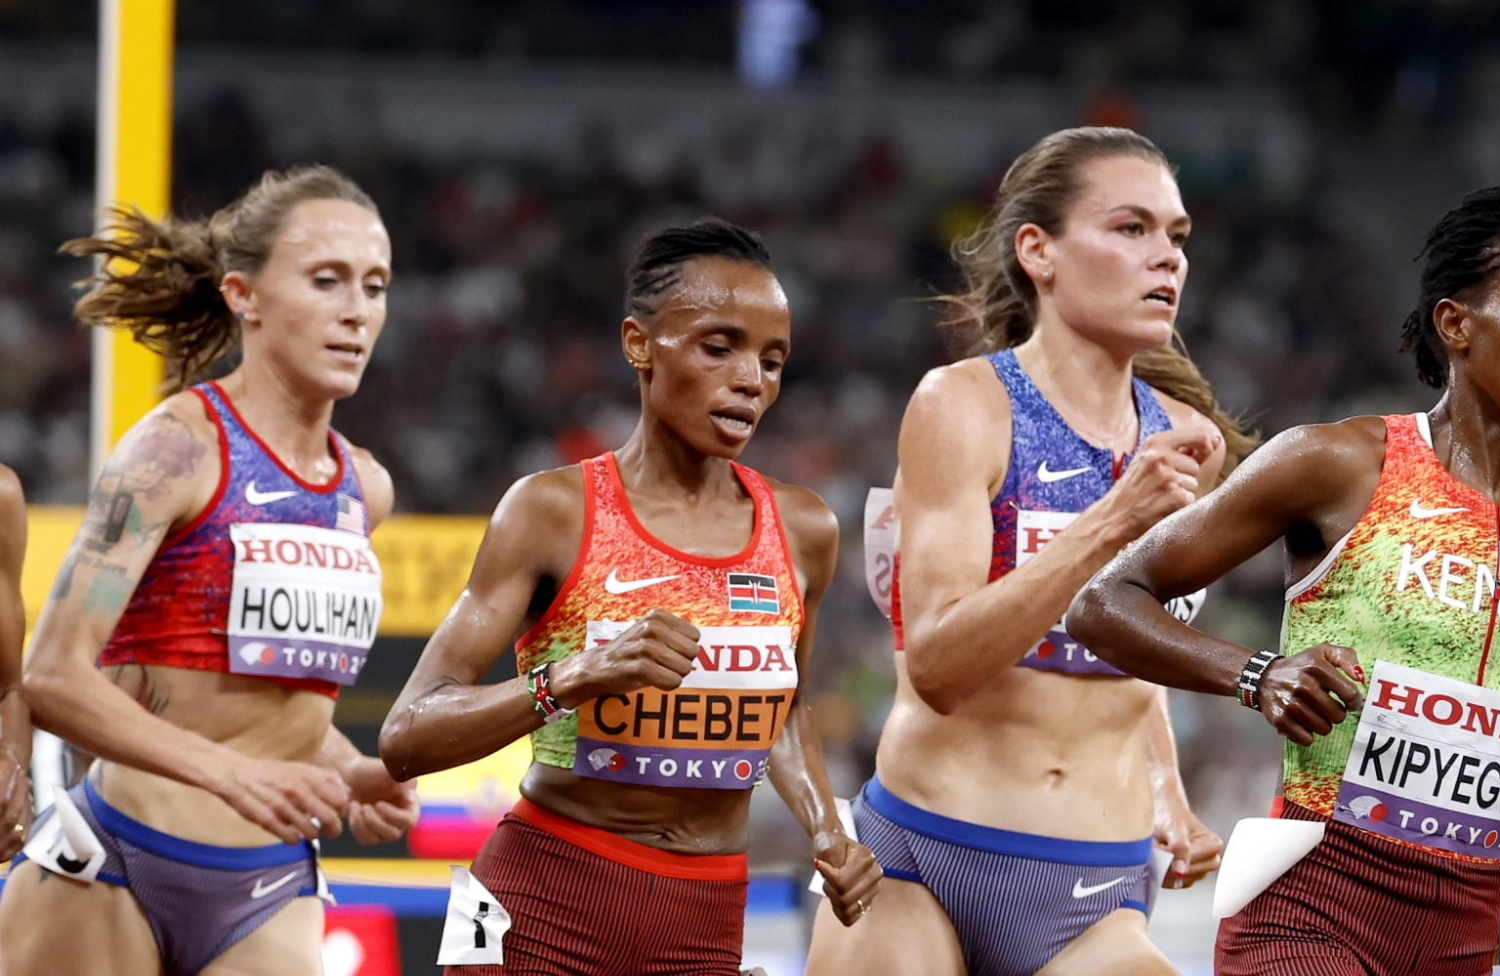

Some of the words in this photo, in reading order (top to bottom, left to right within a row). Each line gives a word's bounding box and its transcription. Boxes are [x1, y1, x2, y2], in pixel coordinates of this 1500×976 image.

[238, 539, 378, 575] HONDA
[240, 586, 377, 641] HOULIHAN
[593, 691, 786, 742] CHEBET
